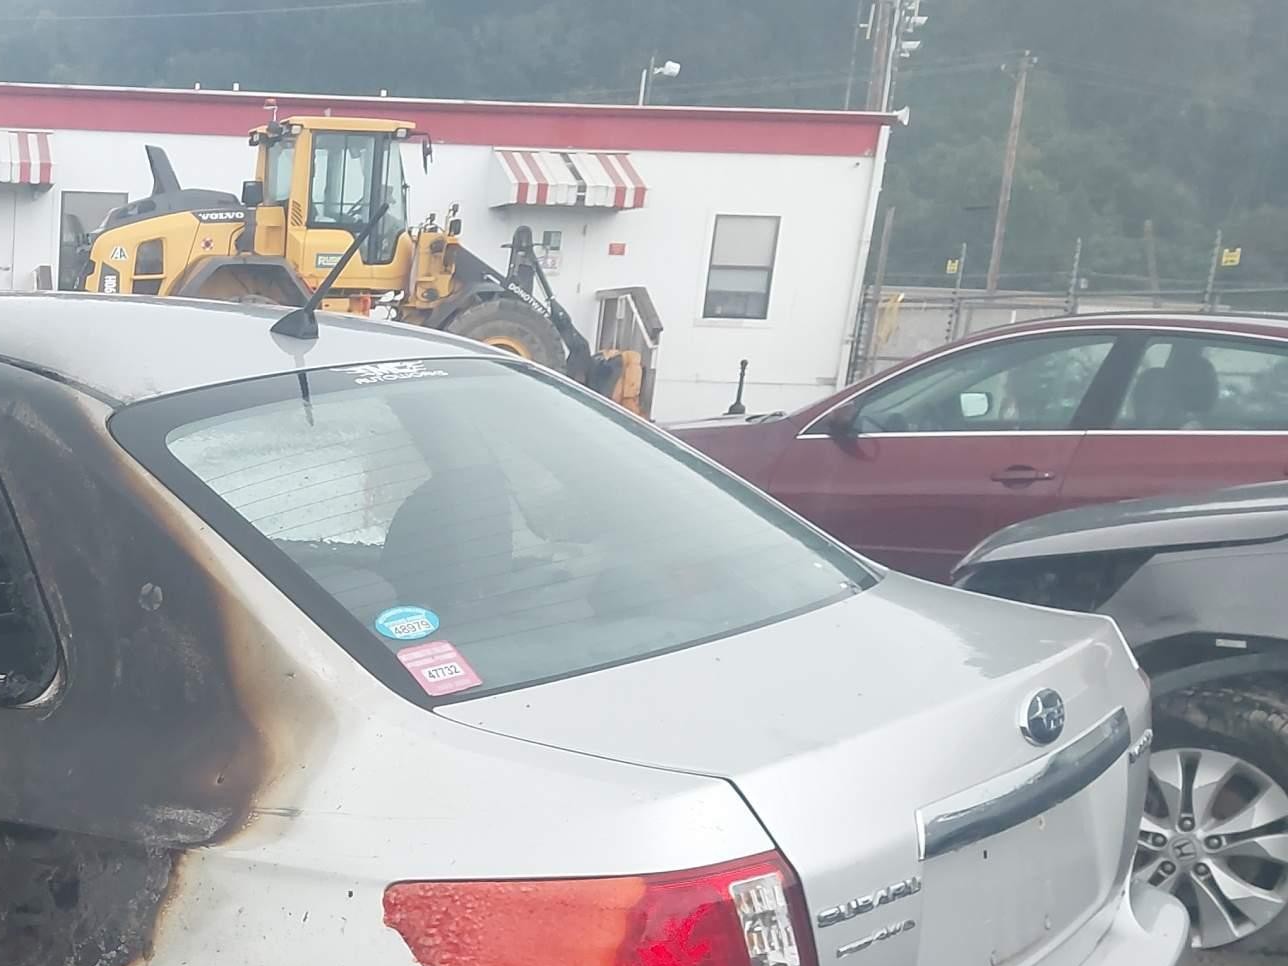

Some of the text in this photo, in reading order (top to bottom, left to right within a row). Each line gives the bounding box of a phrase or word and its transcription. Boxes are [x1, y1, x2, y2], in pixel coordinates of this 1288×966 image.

[198, 211, 245, 220] VOLVO
[394, 620, 431, 635] 48979
[427, 664, 461, 680] 47732
[816, 876, 921, 929] SUBARU
